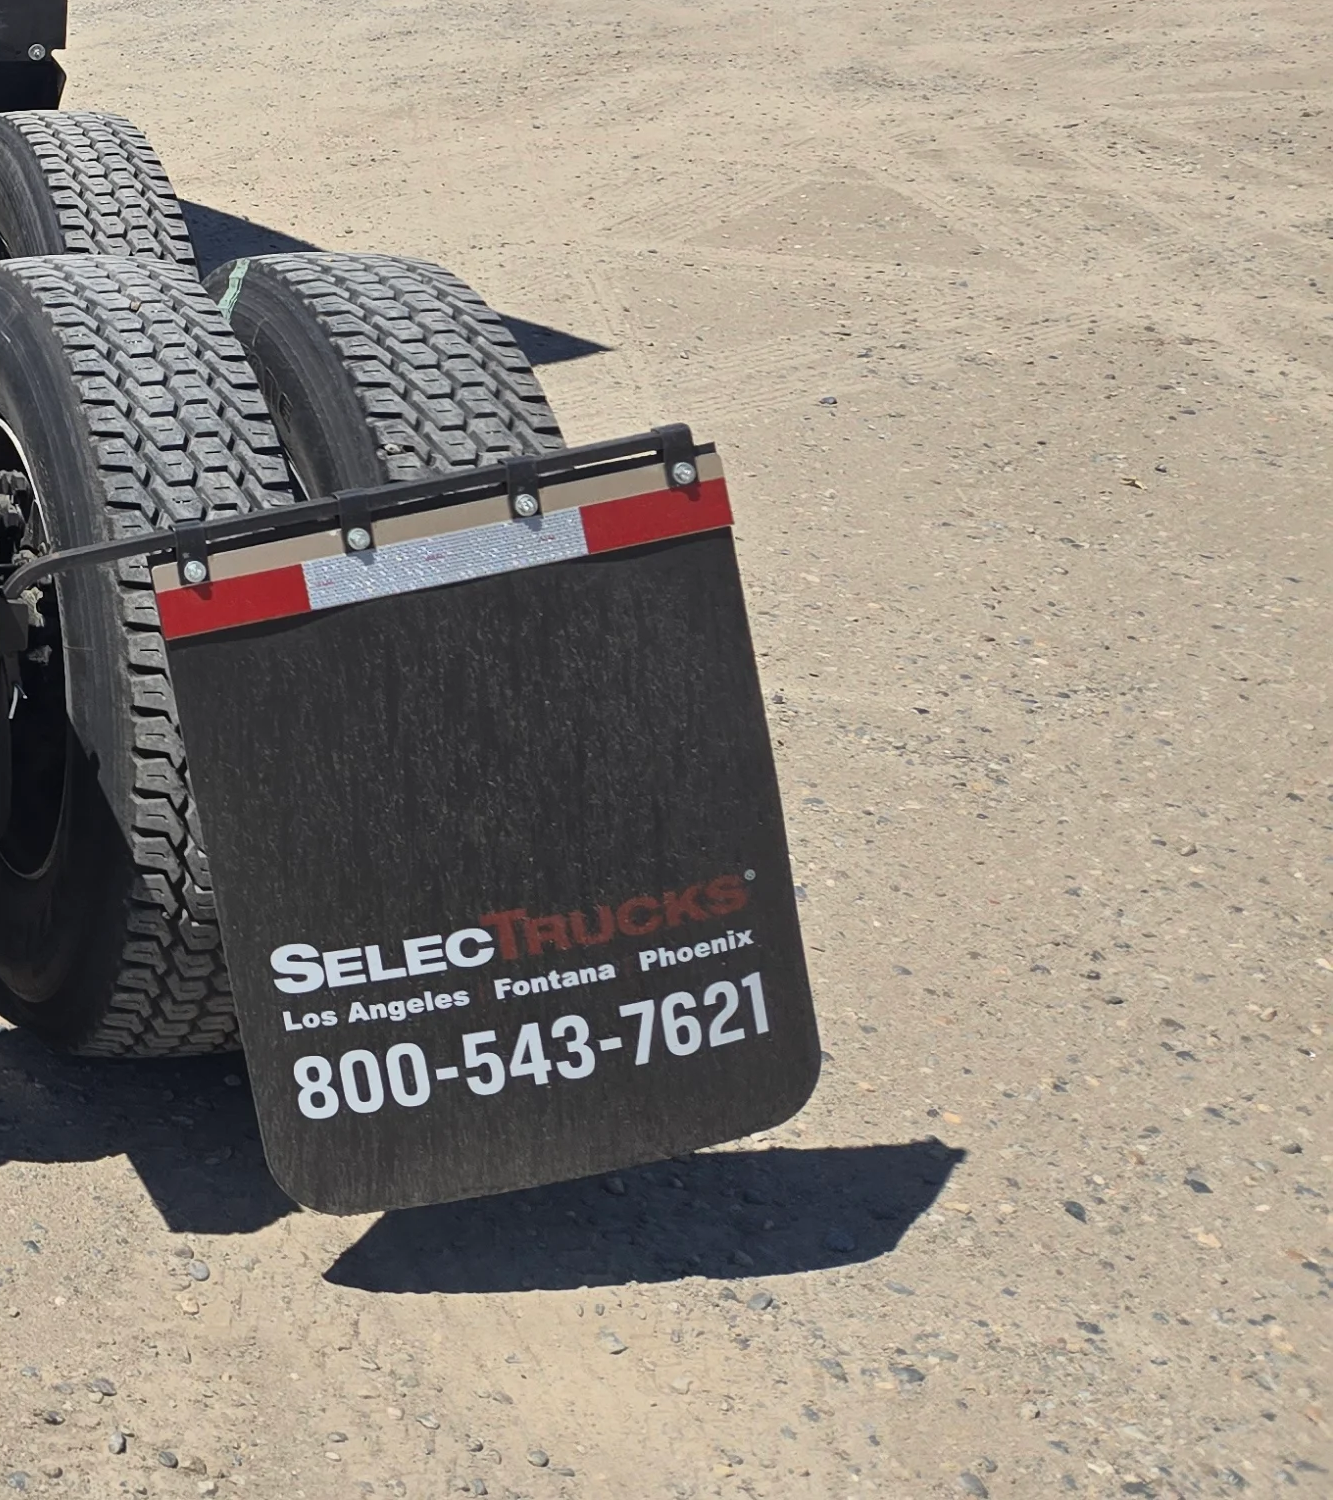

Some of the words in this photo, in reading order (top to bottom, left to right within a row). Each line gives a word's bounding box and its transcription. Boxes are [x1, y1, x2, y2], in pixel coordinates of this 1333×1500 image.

[282, 1009, 339, 1032] Los
[348, 988, 471, 1024] Angeles
[493, 963, 618, 1000] Fontana
[638, 928, 755, 973] Phoenix
[293, 970, 771, 1120] 800-543-7621
